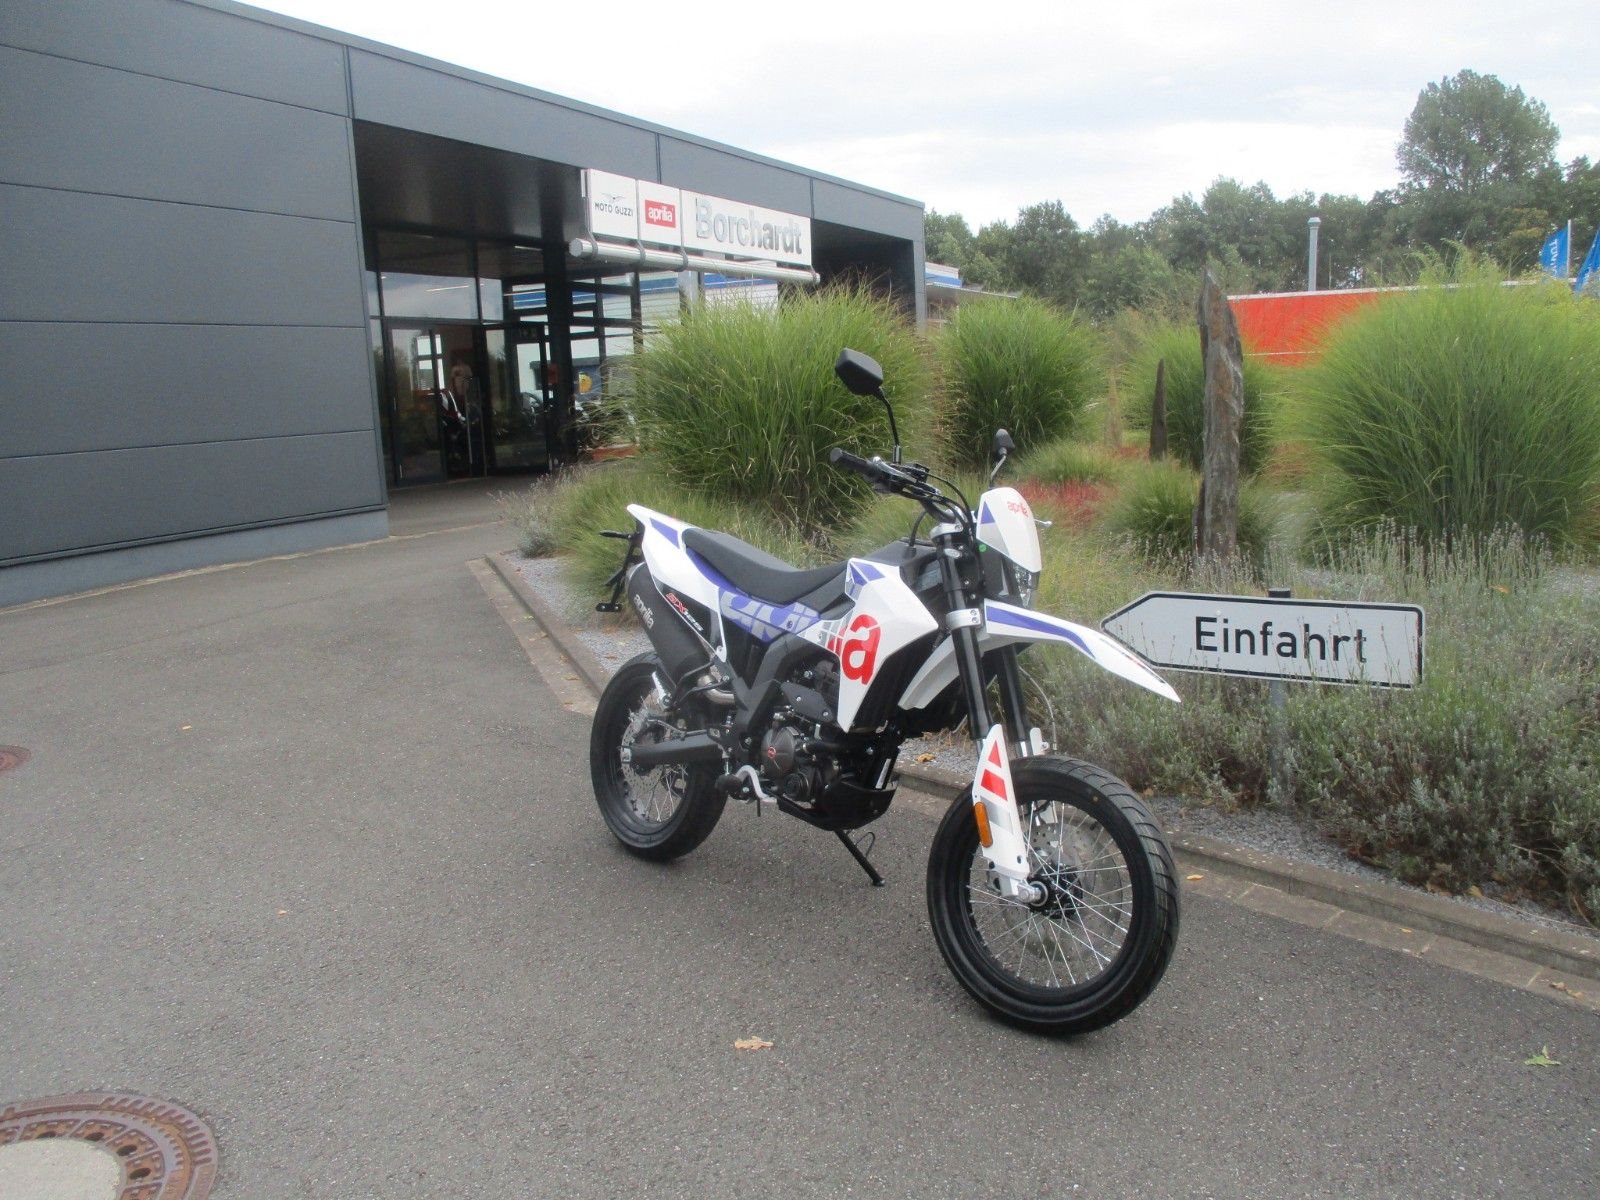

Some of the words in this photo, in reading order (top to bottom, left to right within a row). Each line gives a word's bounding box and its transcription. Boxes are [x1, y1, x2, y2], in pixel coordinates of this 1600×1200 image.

[594, 203, 613, 213] MOTO
[615, 206, 634, 217] GUZZI
[648, 206, 673, 222] aprilia
[696, 198, 802, 254] Borchardt
[1195, 616, 1367, 664] Einfahrt
